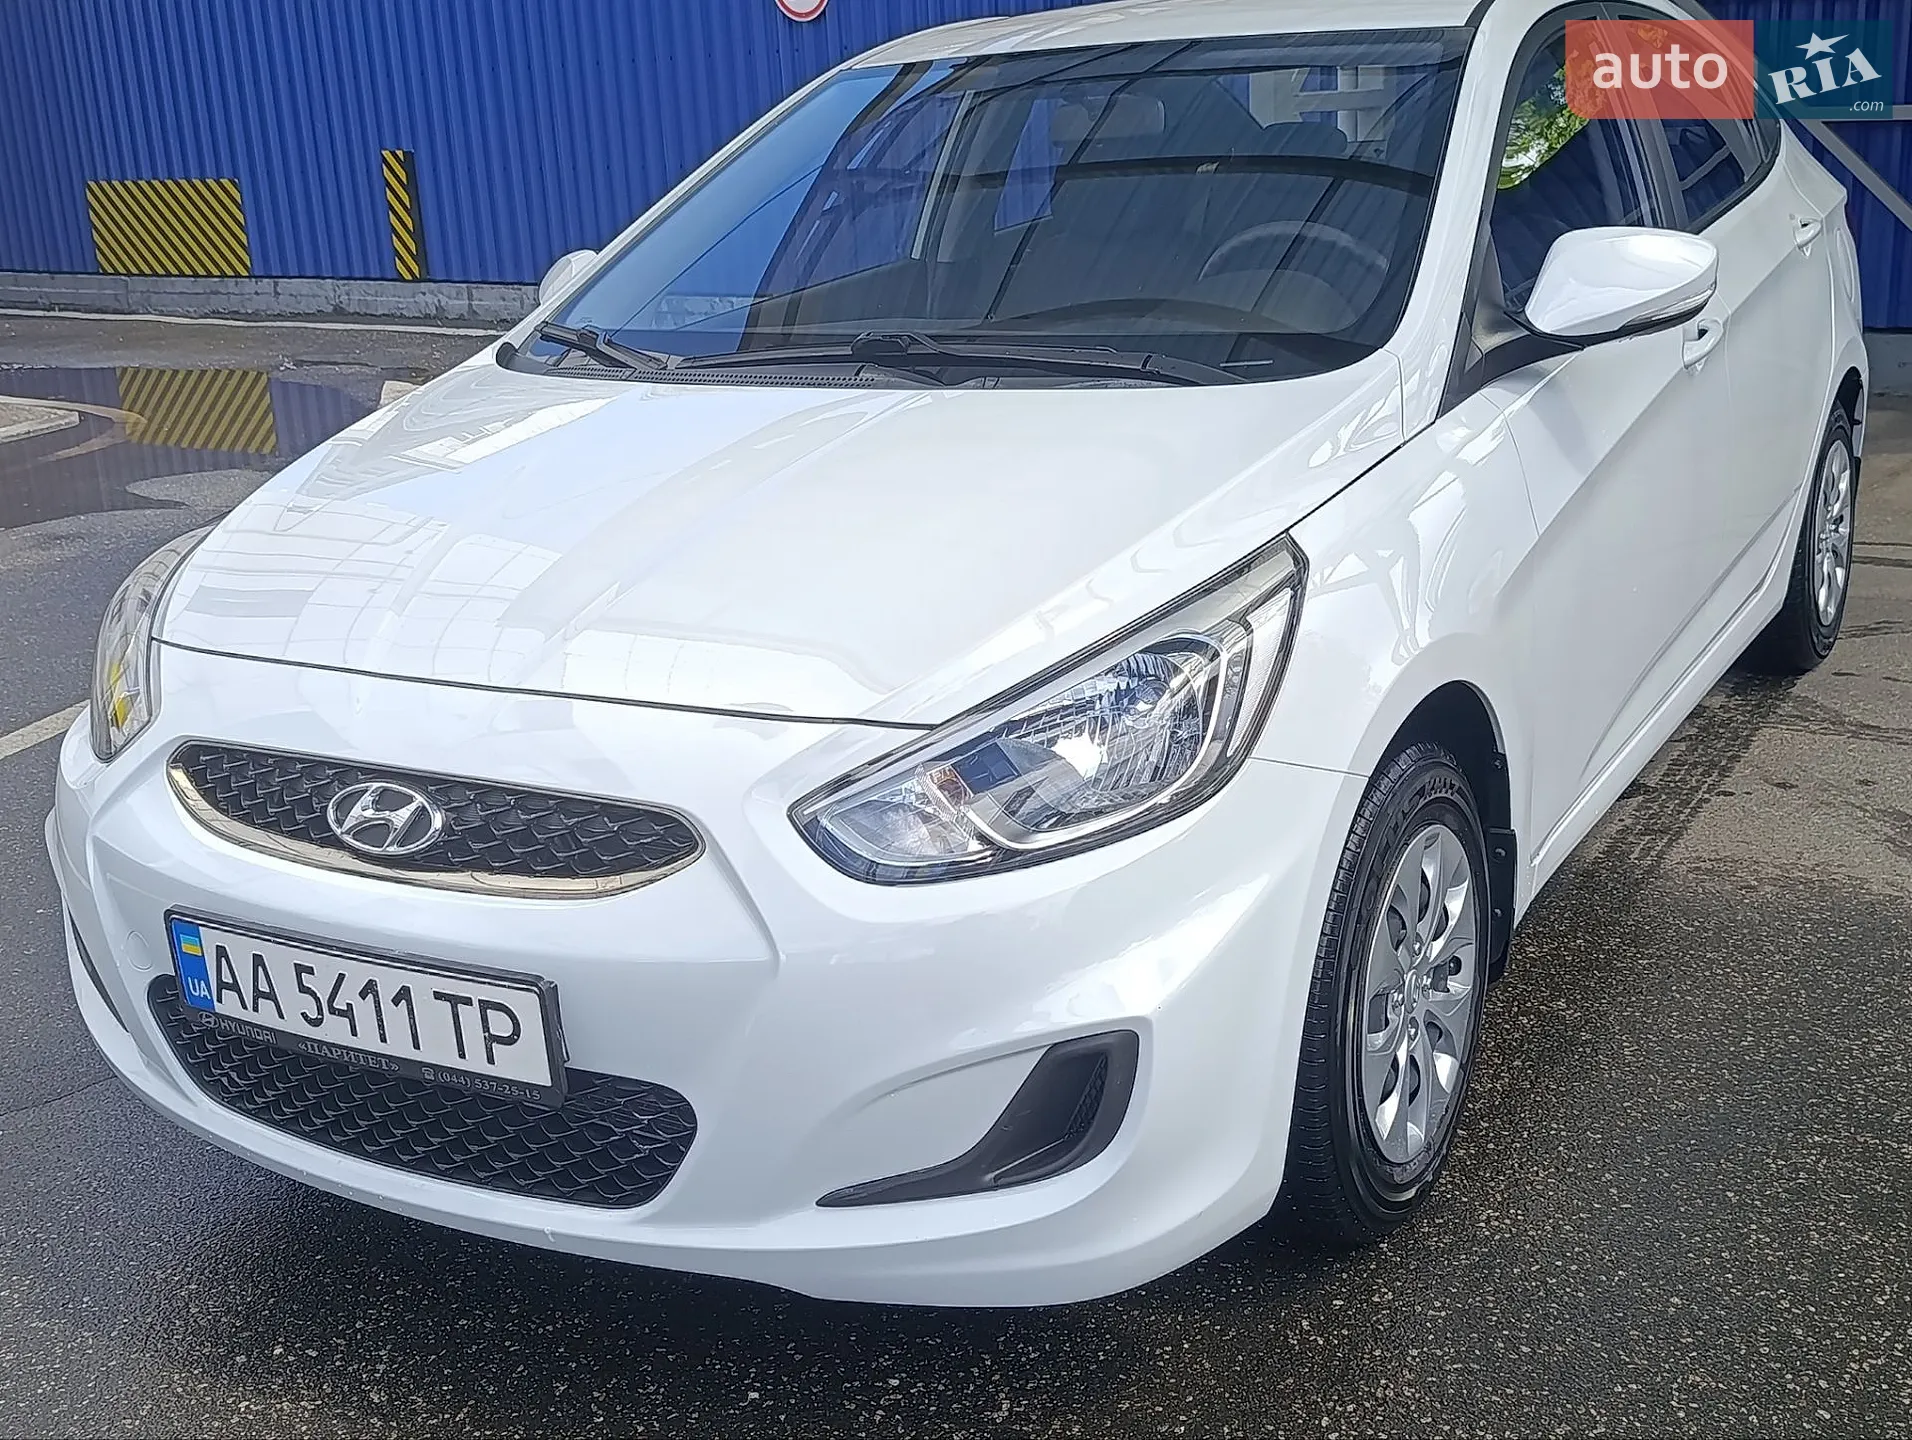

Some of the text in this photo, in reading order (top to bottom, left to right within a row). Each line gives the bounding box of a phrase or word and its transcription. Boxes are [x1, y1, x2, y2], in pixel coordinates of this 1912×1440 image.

[187, 977, 211, 1000] UA
[215, 944, 522, 1066] AA 5411 TP
[219, 1018, 277, 1045] HYUNDAI
[437, 1071, 471, 1087] (044)
